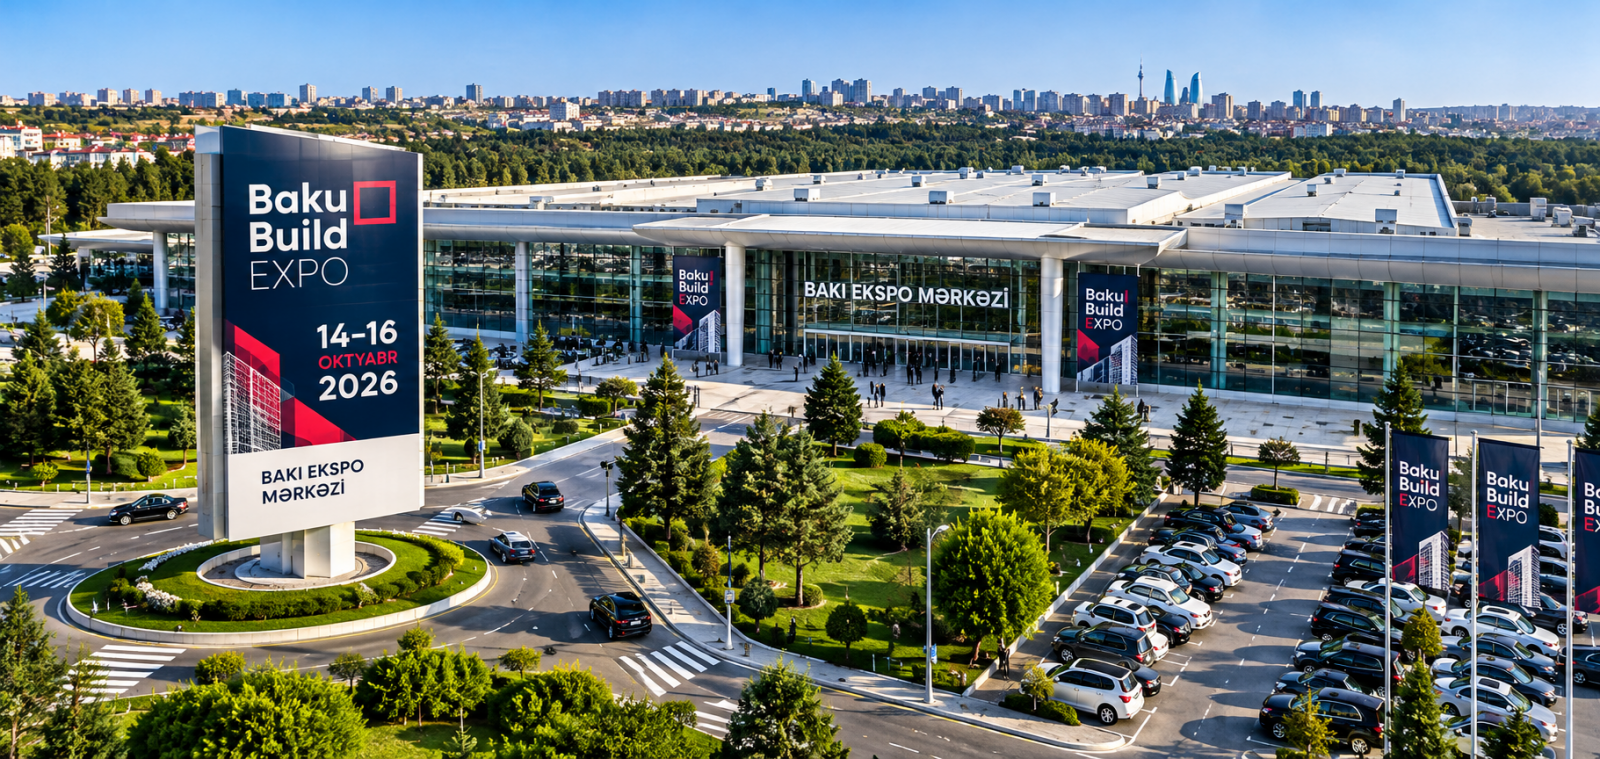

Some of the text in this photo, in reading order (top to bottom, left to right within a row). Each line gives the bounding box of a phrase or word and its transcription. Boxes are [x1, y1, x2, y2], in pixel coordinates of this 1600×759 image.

[249, 182, 347, 215] Baku
[249, 218, 348, 253] Build
[250, 256, 349, 291] EXPO
[679, 280, 709, 294] Build
[804, 281, 1009, 308] BAKI EKSPO MƏRKƏZİ
[679, 294, 708, 306] EXPO
[1086, 302, 1124, 317] Build
[1085, 317, 1123, 330] EXPO
[318, 350, 398, 370] OKTYABR
[318, 370, 398, 402] 2026
[261, 458, 364, 485] BAKI EKSPO
[1400, 460, 1440, 480] Baku
[262, 478, 345, 505] MƏRKƏZİ
[1400, 476, 1440, 497] Build
[1486, 470, 1530, 492] Baku
[1400, 493, 1438, 512] EXPO
[1486, 488, 1530, 509] Build
[1486, 504, 1528, 525] EXPO
